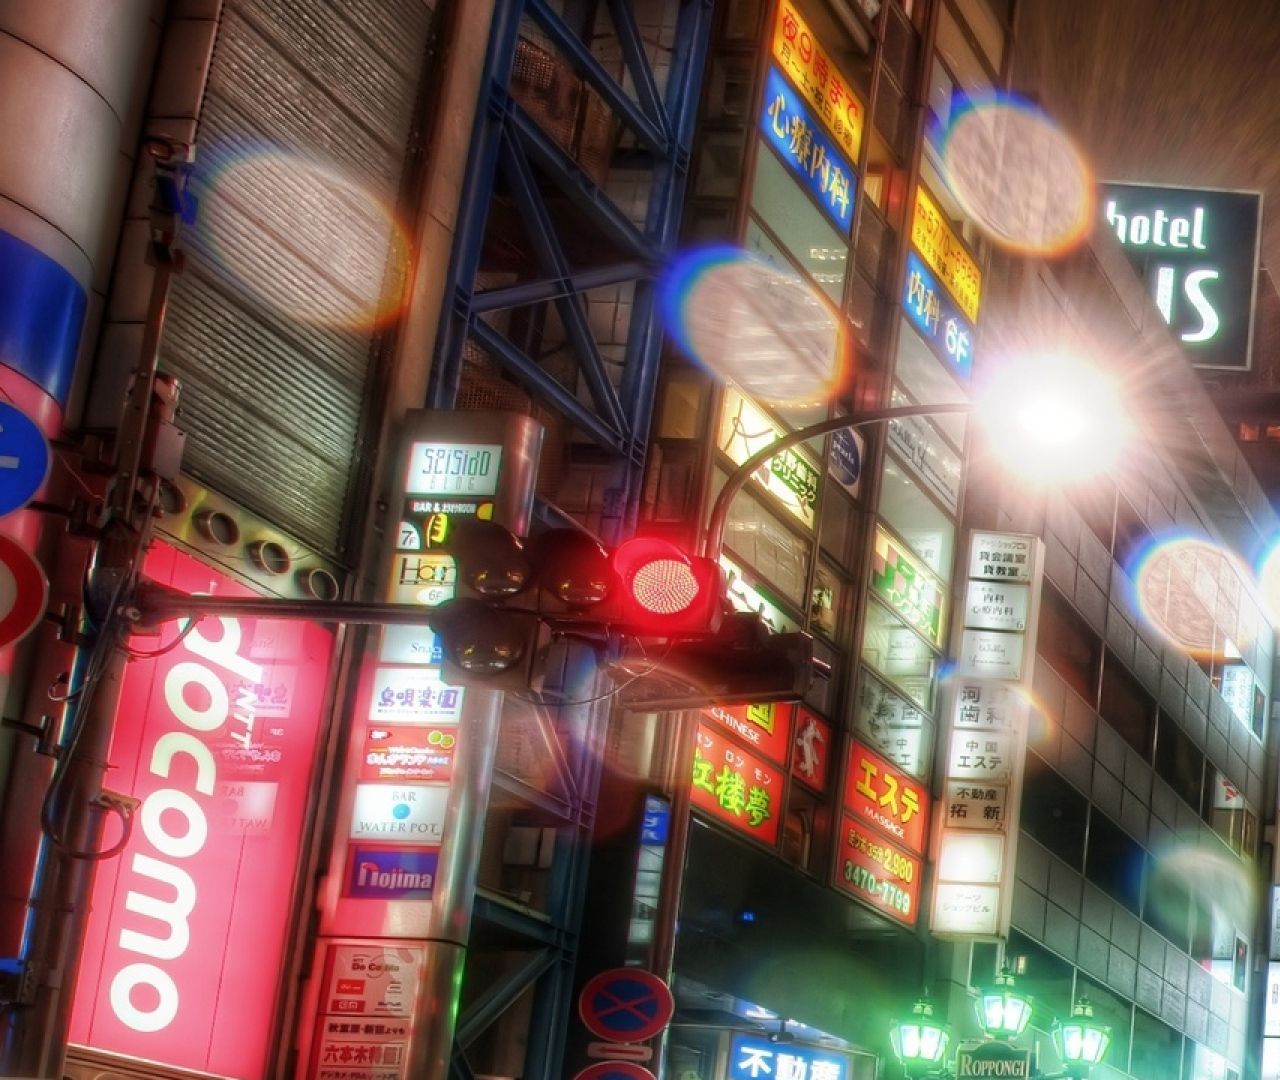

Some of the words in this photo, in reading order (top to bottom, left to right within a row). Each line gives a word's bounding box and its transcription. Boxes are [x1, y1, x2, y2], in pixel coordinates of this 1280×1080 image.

[768, 94, 849, 219] 心療内科
[1106, 200, 1207, 250] hotel
[908, 270, 941, 337] 内科
[945, 317, 969, 364] 6F
[413, 502, 432, 513] BAR
[979, 551, 1027, 564] 貸会議室
[983, 565, 1019, 576] 貸教室
[983, 594, 1004, 604] 内科
[230, 686, 260, 751] NTT
[710, 706, 761, 745] CHINESE
[965, 740, 998, 753] 中国
[957, 755, 1003, 769] エステ
[391, 791, 417, 802] BAR
[855, 758, 920, 824] エステ
[956, 787, 998, 800] 不動産
[109, 592, 269, 1032] docomo
[357, 821, 406, 834] WATER
[409, 822, 439, 834] POT
[863, 806, 905, 839] MASSAGE
[959, 1054, 1028, 1078] ROPPONGI
